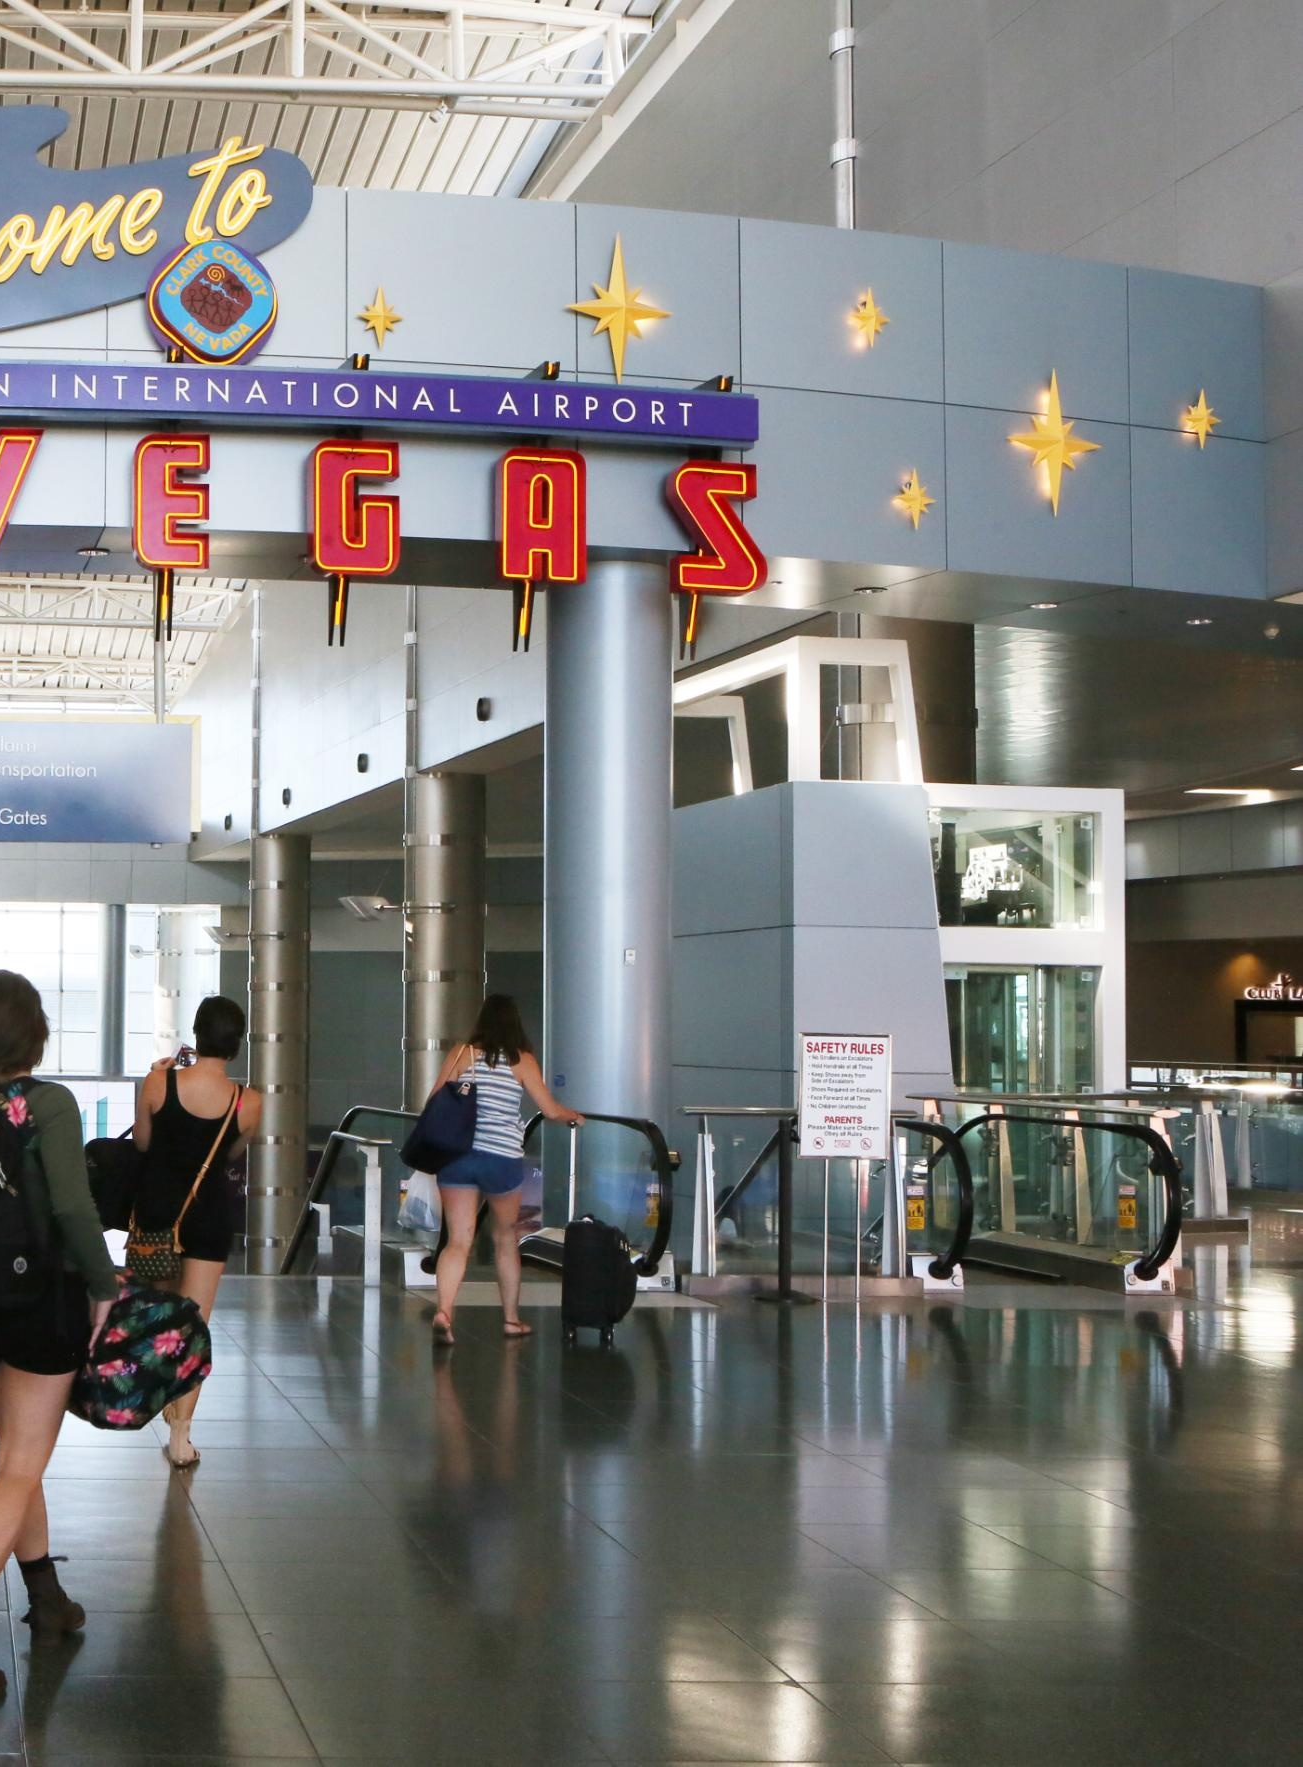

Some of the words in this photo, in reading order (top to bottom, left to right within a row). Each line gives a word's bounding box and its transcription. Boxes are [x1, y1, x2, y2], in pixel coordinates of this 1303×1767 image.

[185, 136, 273, 245] to
[165, 249, 209, 296] CLARK
[212, 246, 269, 297] COUNTY
[183, 322, 253, 351] NEVADA
[51, 373, 462, 414] INTERNATIONAL
[497, 391, 693, 427] AIRPORT
[806, 1041, 848, 1054] SAFETY
[850, 1043, 885, 1055] RULES
[824, 1115, 863, 1124] PARENTS
